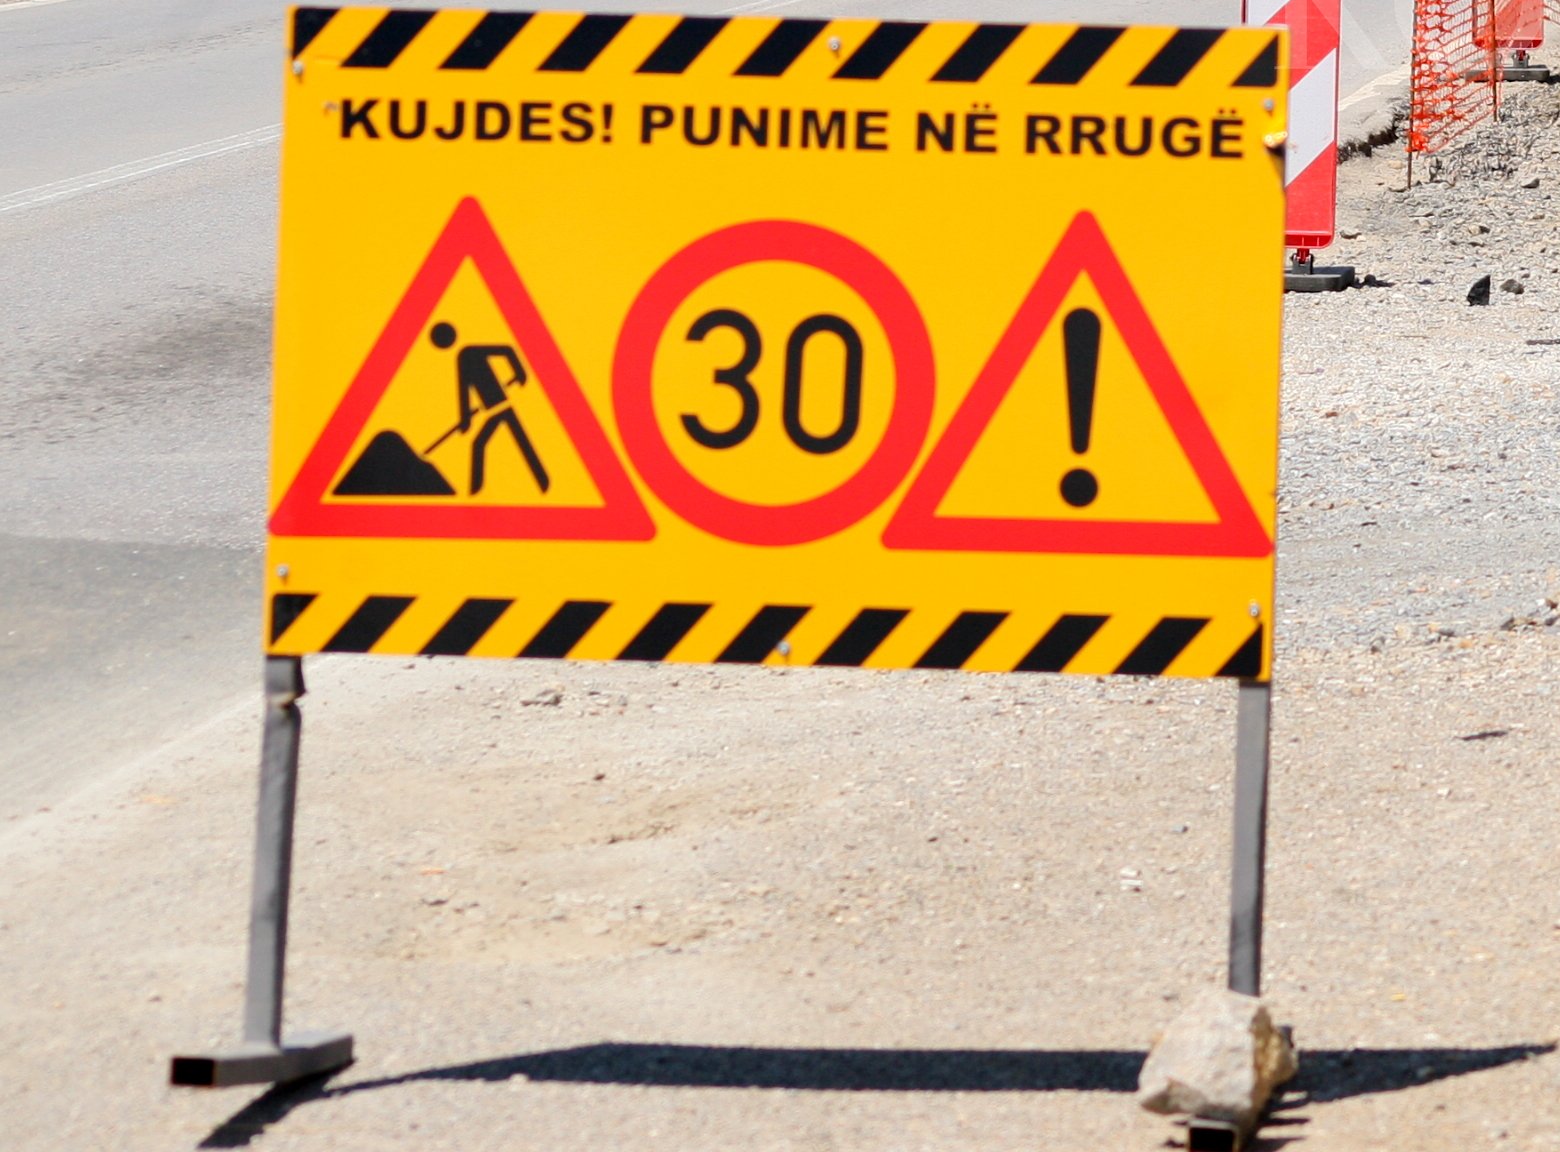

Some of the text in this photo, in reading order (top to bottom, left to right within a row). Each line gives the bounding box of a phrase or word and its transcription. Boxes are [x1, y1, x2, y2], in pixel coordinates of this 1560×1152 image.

[339, 98, 1245, 159] KUJDES! PUNIME NË RRUGË
[679, 308, 864, 455] 30
